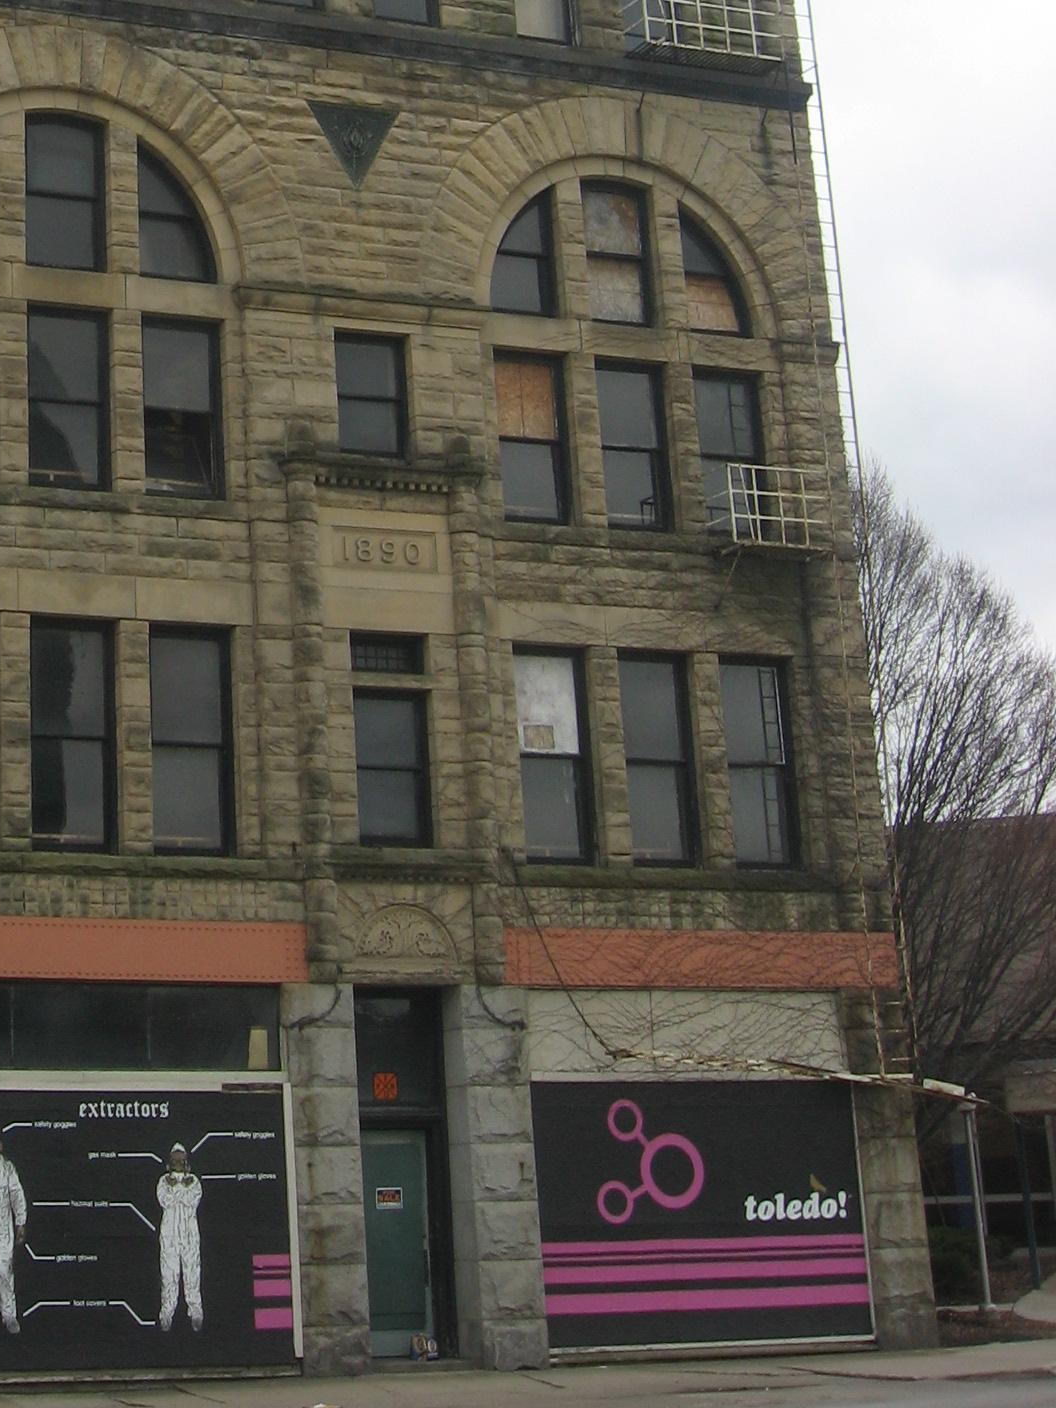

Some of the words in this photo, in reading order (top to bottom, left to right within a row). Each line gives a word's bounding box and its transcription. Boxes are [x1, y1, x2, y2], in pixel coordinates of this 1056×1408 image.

[343, 535, 421, 566] 1890
[79, 1100, 170, 1119] extractors
[745, 1191, 847, 1221] toledo!
